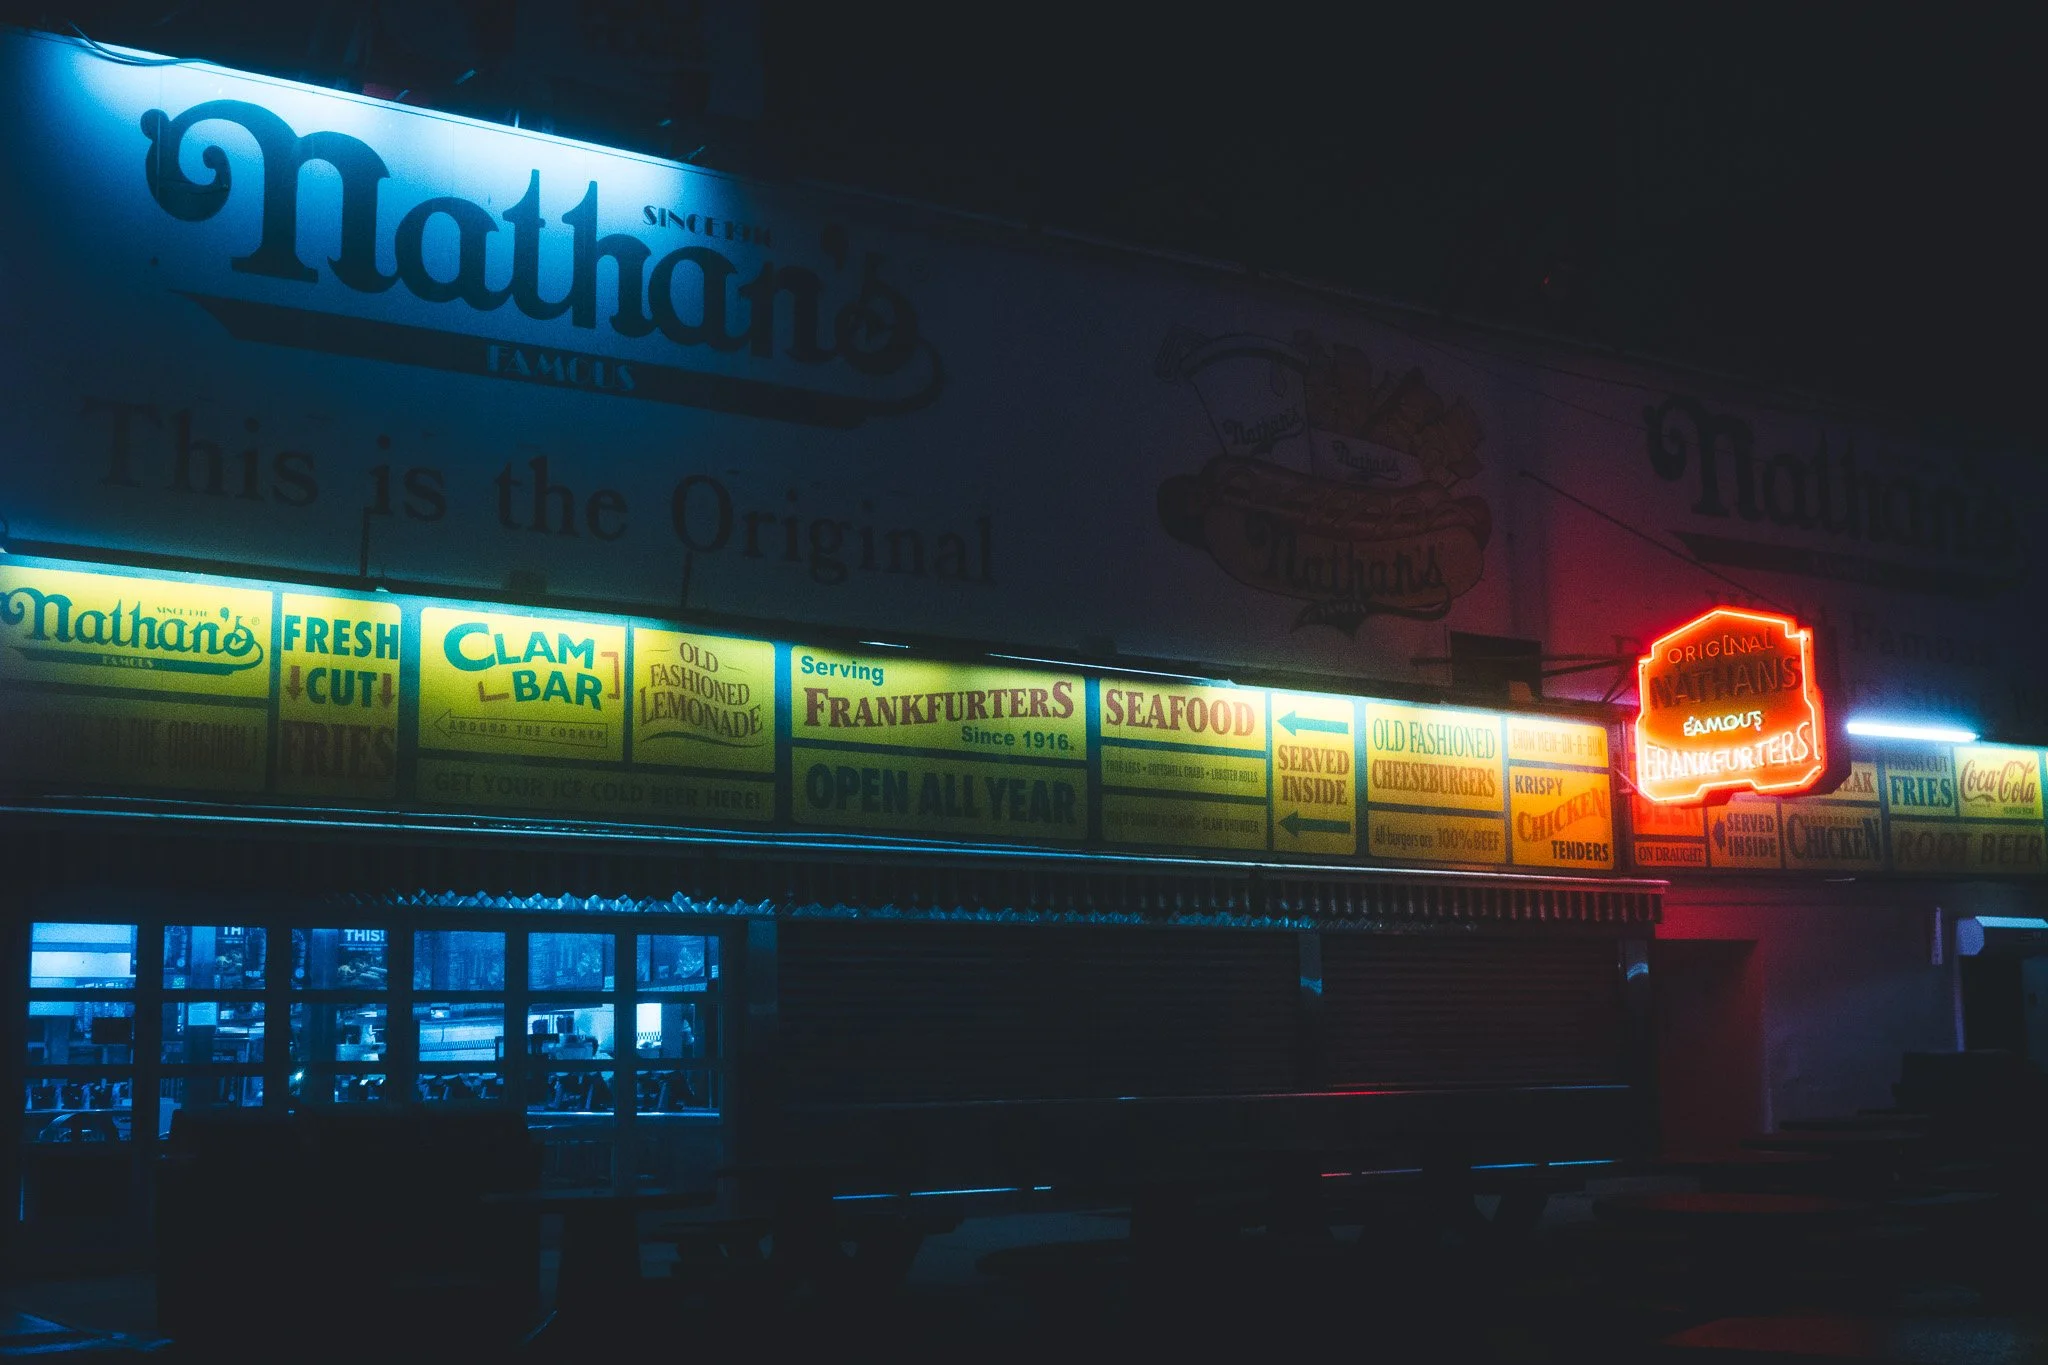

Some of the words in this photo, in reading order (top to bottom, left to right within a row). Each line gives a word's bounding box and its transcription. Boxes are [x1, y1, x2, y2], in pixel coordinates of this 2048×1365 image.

[141, 98, 918, 375] Nathan's
[643, 205, 720, 239] SINCE
[487, 344, 639, 393] FAMOUS
[80, 394, 320, 507] This
[368, 433, 449, 522] is
[493, 454, 630, 541] the
[670, 470, 998, 586] Original
[0, 587, 255, 658] Nathan's
[283, 614, 400, 660] FRESH
[443, 621, 596, 672] CLAM
[678, 641, 719, 674] OLD
[1667, 627, 1774, 664] ORIGINAL
[305, 667, 378, 708] CUT
[650, 662, 751, 707] FASHIONED
[800, 655, 885, 687] Serving
[511, 669, 603, 712] BAR
[803, 680, 1075, 729] FRANKFURTERS
[450, 719, 508, 734] AROUND
[516, 724, 542, 737] THE
[549, 727, 605, 740] CORNER
[639, 685, 764, 740] LEMONADE
[1106, 688, 1256, 737] SEAFOOD
[1683, 711, 1762, 737] FAMOUS
[281, 719, 396, 781] FRIES
[961, 725, 1015, 747] Since
[1021, 730, 1075, 751] 1916.
[1373, 718, 1405, 752] OLD
[1409, 721, 1496, 760] FASHIONED
[1512, 728, 1536, 750] CHOW
[1645, 721, 1811, 782] FRANKFURTERS
[1278, 744, 1350, 776] SERVED
[1927, 755, 1949, 773] CUT
[433, 771, 475, 796] GET
[484, 772, 544, 799] YOUR
[590, 781, 644, 804] COLD
[805, 763, 910, 815] OPEN
[917, 771, 982, 819] ALL
[984, 775, 1078, 825] YEAR
[1281, 775, 1348, 806] INSIDE
[1372, 759, 1496, 799] CHEESEBURGERS
[1514, 774, 1564, 797] KRISPY
[1889, 775, 1953, 808] FRIES
[1959, 758, 2037, 803] Coca-Cola
[1517, 786, 1609, 843] CHICKEN
[1726, 812, 1775, 833] SERVED
[1437, 828, 1473, 850] 100%
[1474, 829, 1501, 851] BEEF
[1551, 840, 1609, 862] TENDERS
[1638, 846, 1653, 861] ON
[1655, 847, 1703, 864] DRAUGHT
[1728, 834, 1777, 858] INSIDE
[1786, 813, 1884, 862] CHICKEN
[1899, 830, 1973, 865] ROOT
[1980, 832, 2044, 867] BEER
[344, 928, 385, 942] THIS!
